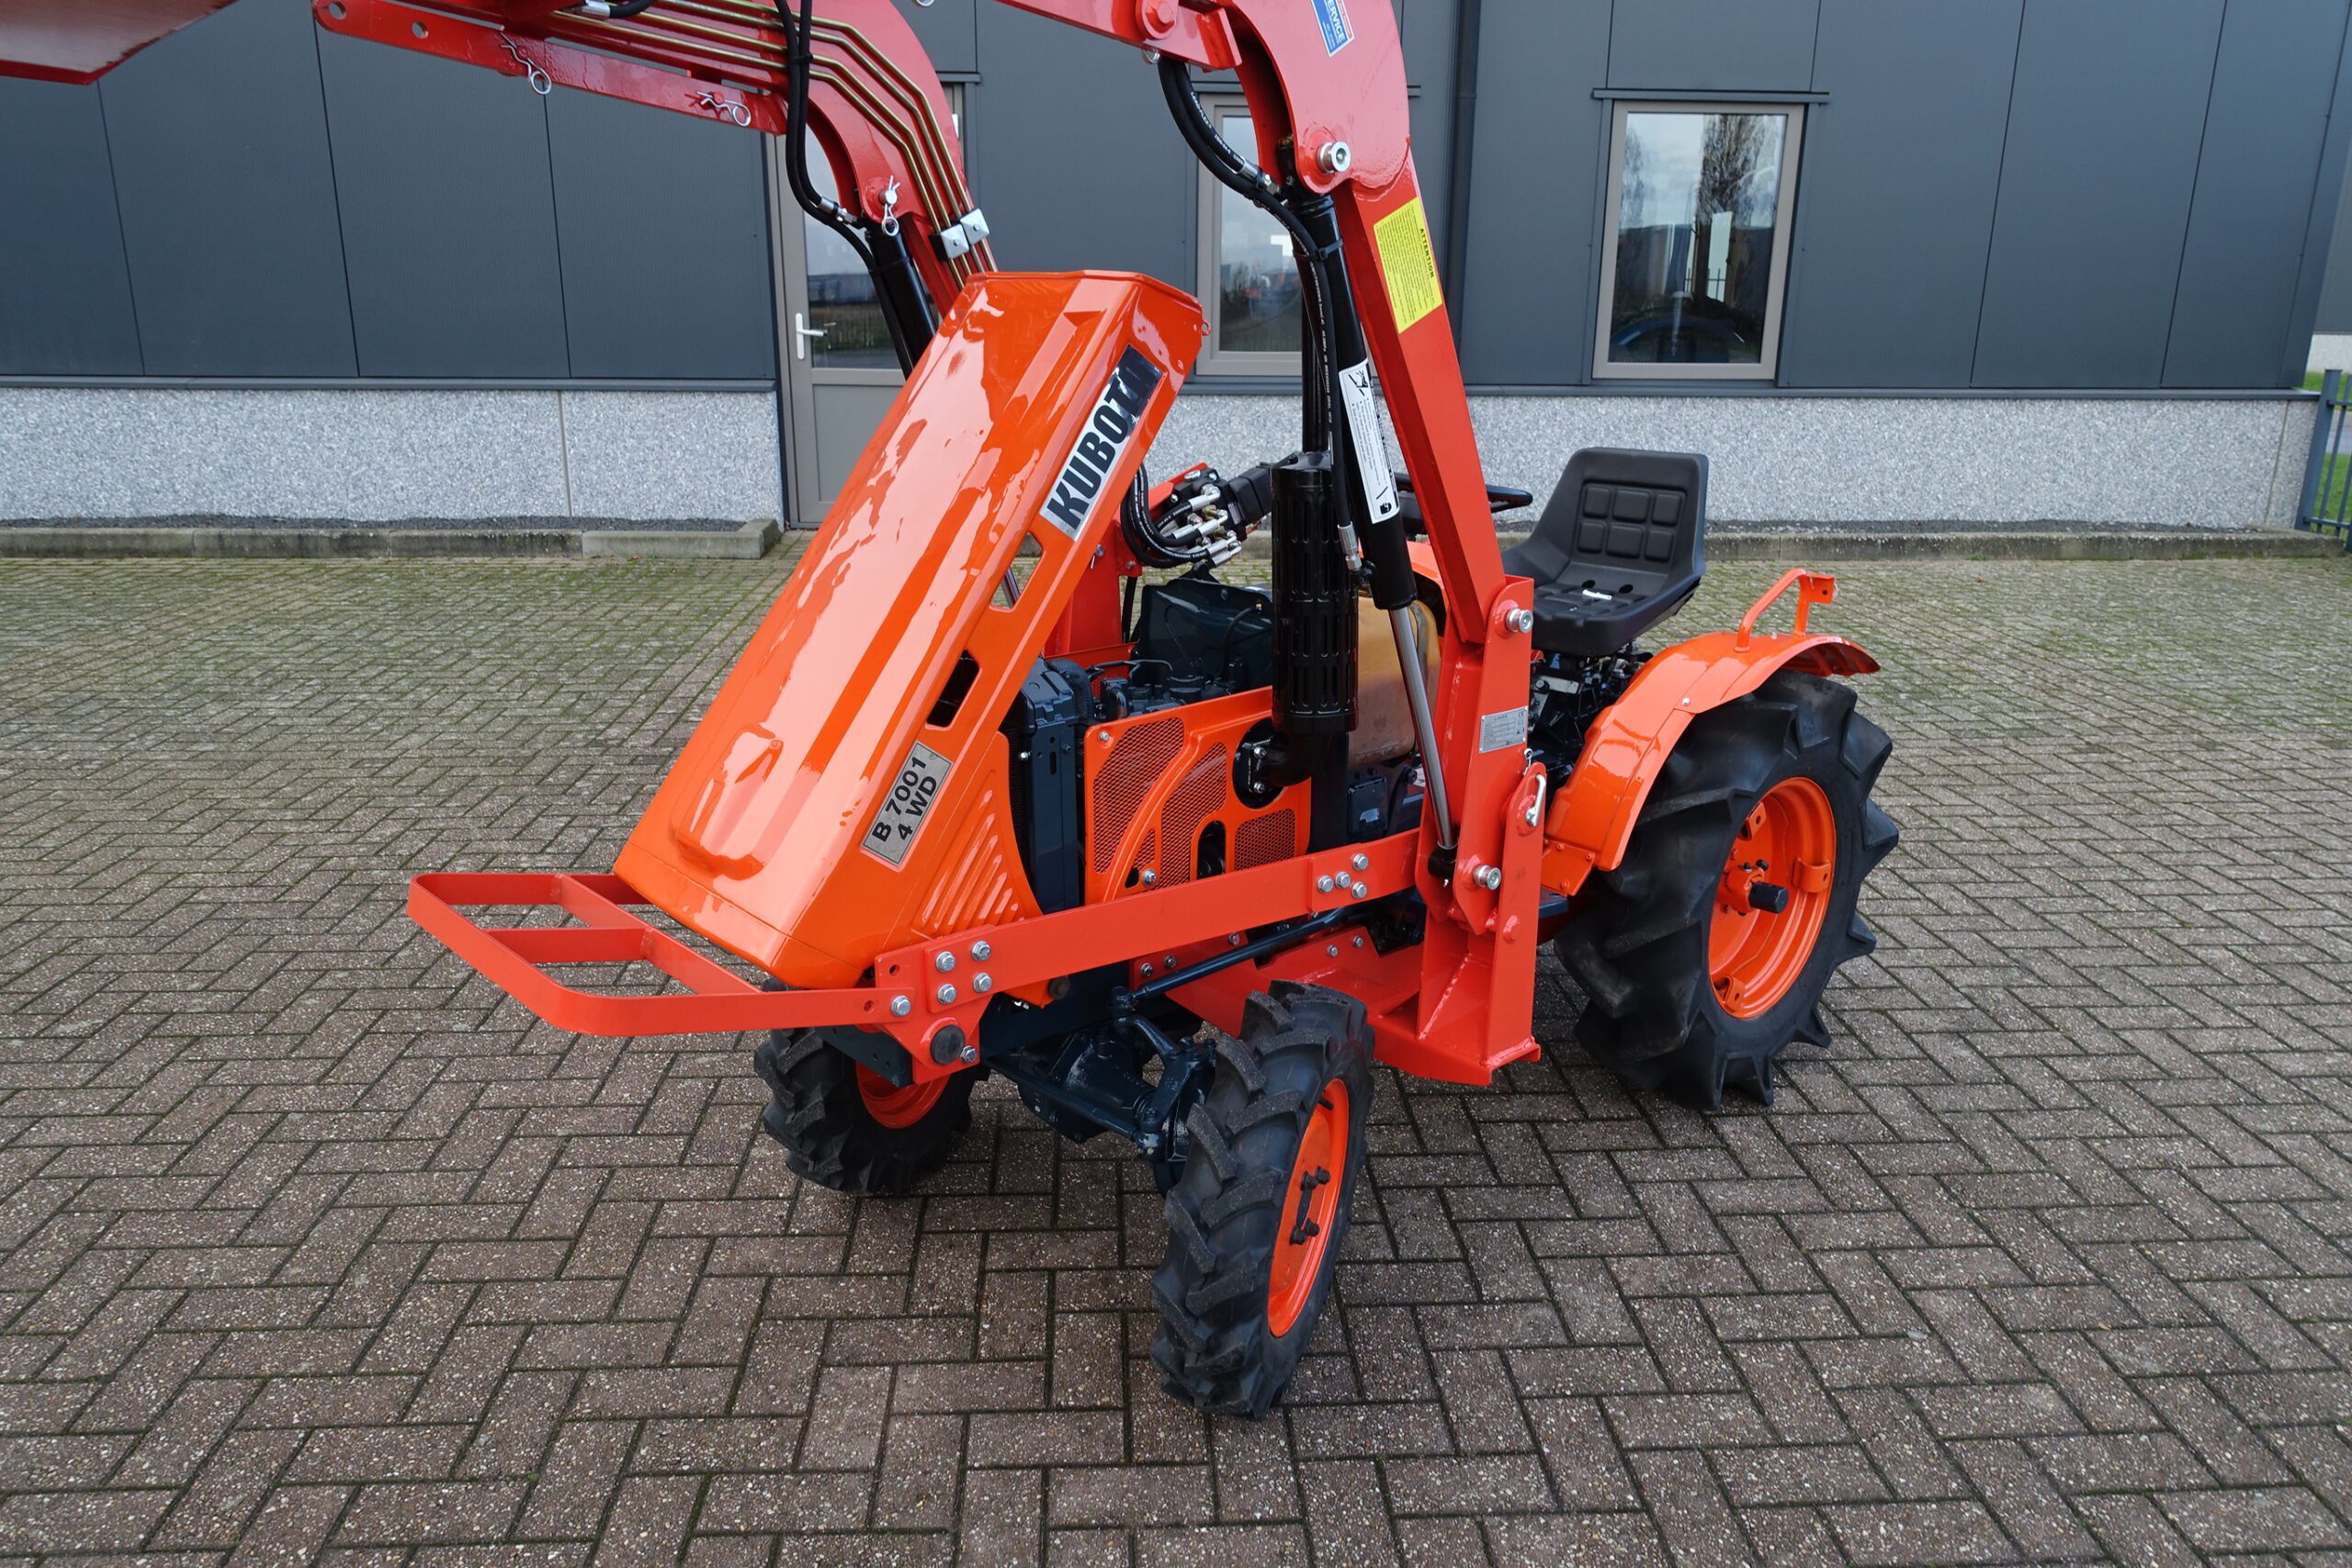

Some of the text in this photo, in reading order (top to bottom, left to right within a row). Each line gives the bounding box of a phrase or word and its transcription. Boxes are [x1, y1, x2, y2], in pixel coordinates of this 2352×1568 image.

[1419, 228, 1435, 277] ATTENTION
[872, 756, 926, 842] B 7001
[898, 775, 937, 840] 4 WD
